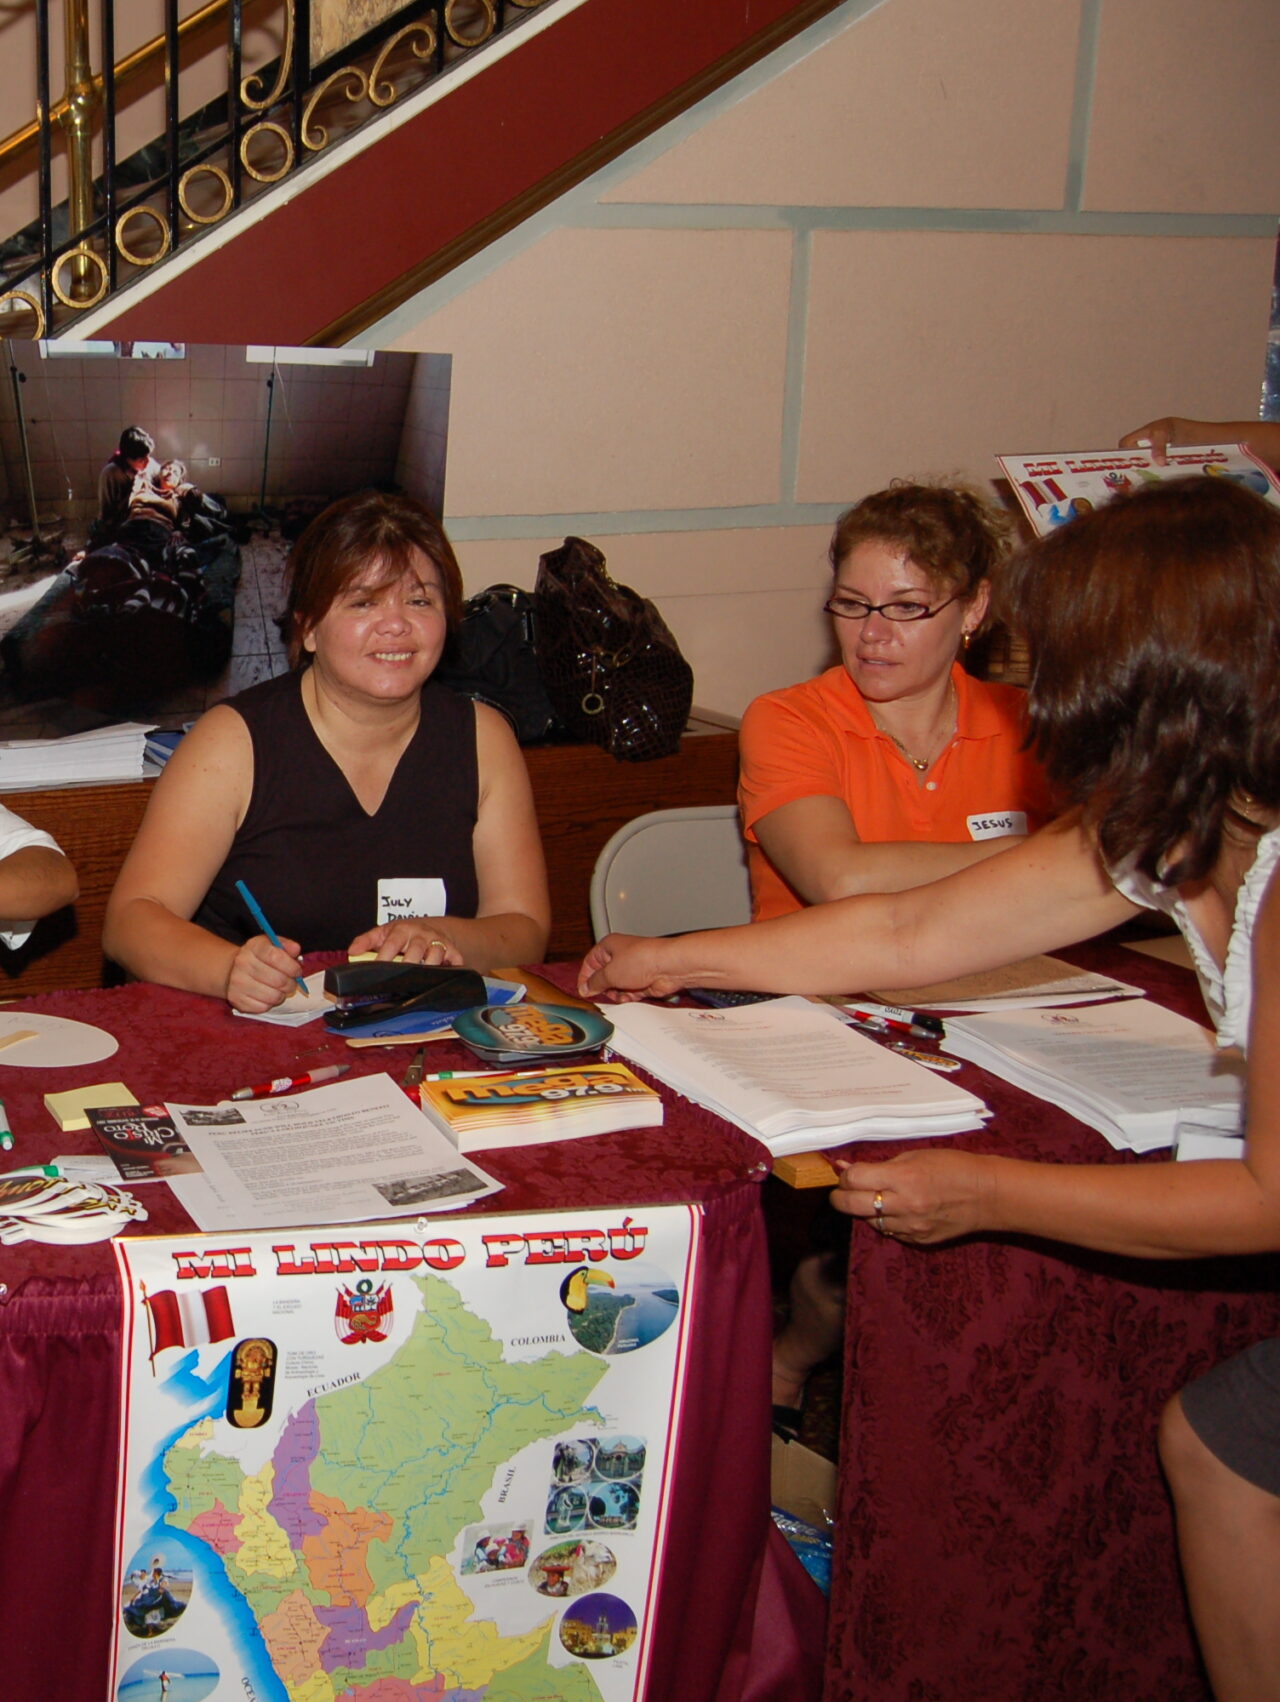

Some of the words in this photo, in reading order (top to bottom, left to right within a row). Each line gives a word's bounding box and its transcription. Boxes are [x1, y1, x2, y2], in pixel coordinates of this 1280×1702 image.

[1023, 461, 1064, 477] MI
[1065, 456, 1150, 474] LINDO
[972, 817, 1013, 831] JESUS
[381, 896, 413, 908] JULY
[445, 1074, 631, 1100] mega
[540, 1084, 624, 1100] 97.9
[172, 1247, 257, 1279] MI
[272, 1238, 466, 1276] LINDO
[482, 1216, 649, 1268] PERÚ
[510, 1333, 566, 1347] COLOMBIA
[307, 1371, 362, 1398] ECUADOR
[498, 1466, 517, 1503] BRASIL
